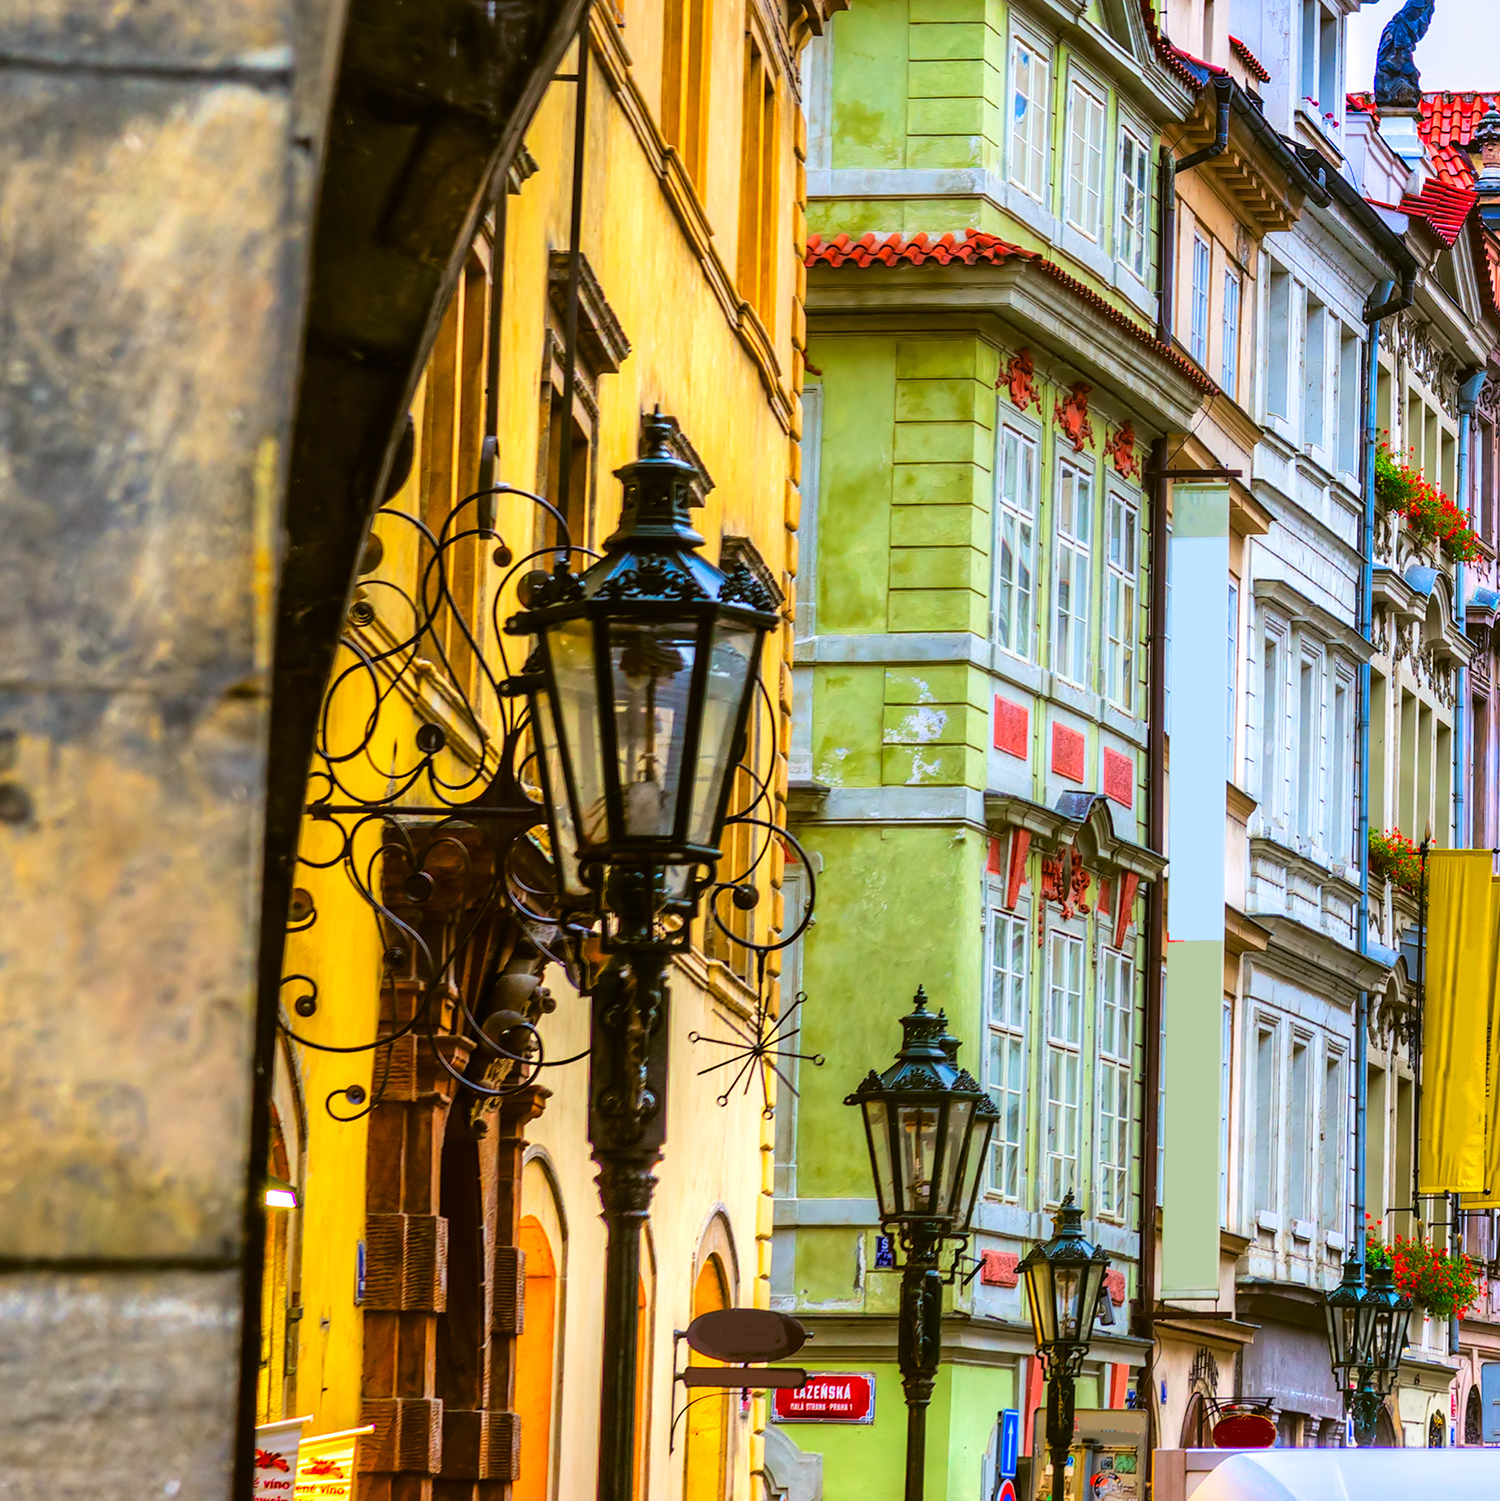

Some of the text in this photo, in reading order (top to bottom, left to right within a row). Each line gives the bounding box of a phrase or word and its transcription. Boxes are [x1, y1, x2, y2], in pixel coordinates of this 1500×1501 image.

[805, 1402, 826, 1411] STRANA
[829, 1402, 848, 1411] PRAHA
[264, 1478, 290, 1490] víno
[320, 1484, 345, 1495] víno
